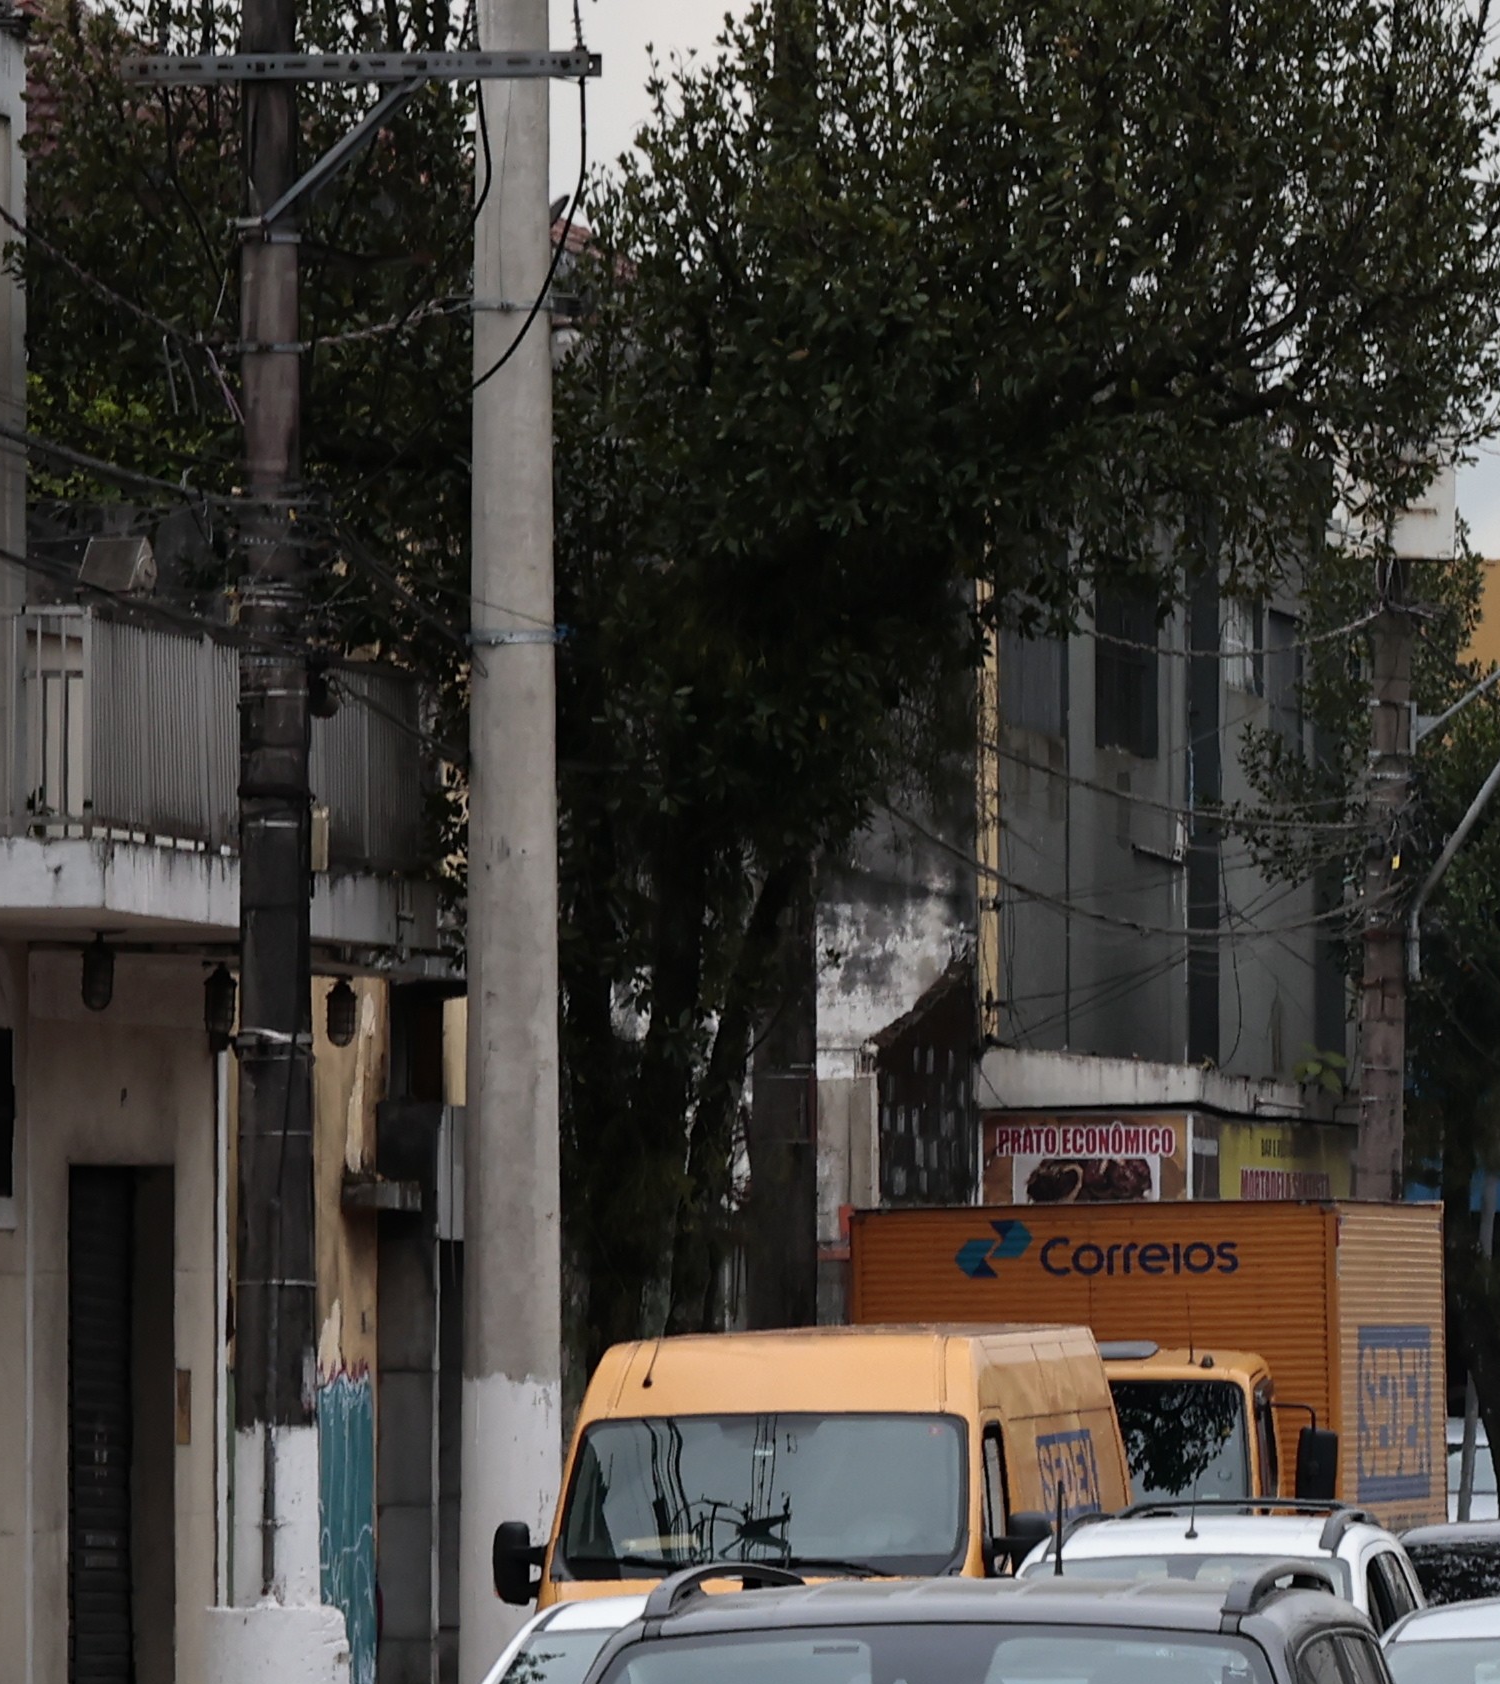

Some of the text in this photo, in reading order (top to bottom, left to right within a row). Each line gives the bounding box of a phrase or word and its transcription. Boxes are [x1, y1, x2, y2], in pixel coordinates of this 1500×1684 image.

[998, 1121, 1174, 1156] PRATO ECONÔMICO
[1040, 1237, 1240, 1276] Correios
